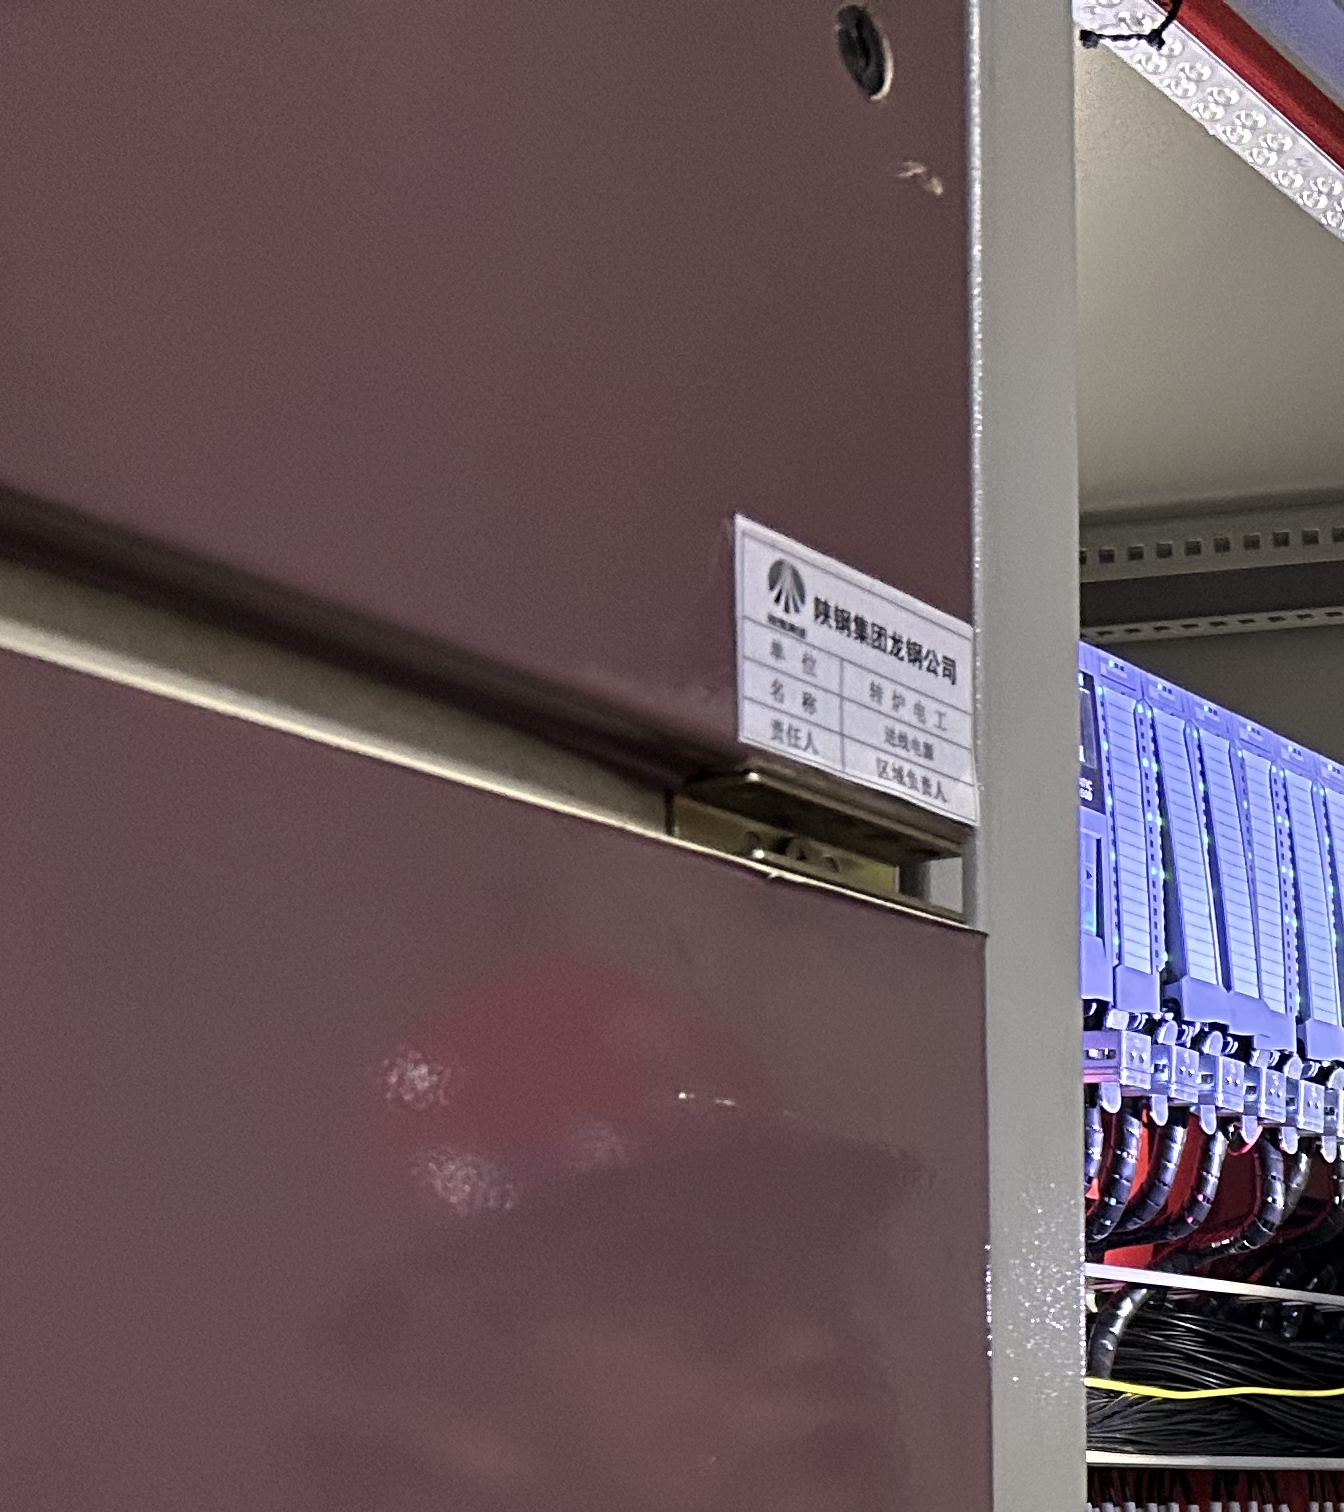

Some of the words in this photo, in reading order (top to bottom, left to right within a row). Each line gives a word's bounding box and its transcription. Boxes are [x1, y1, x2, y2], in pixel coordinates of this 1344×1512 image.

[813, 596, 957, 685] 陕钢集团龙钢公司
